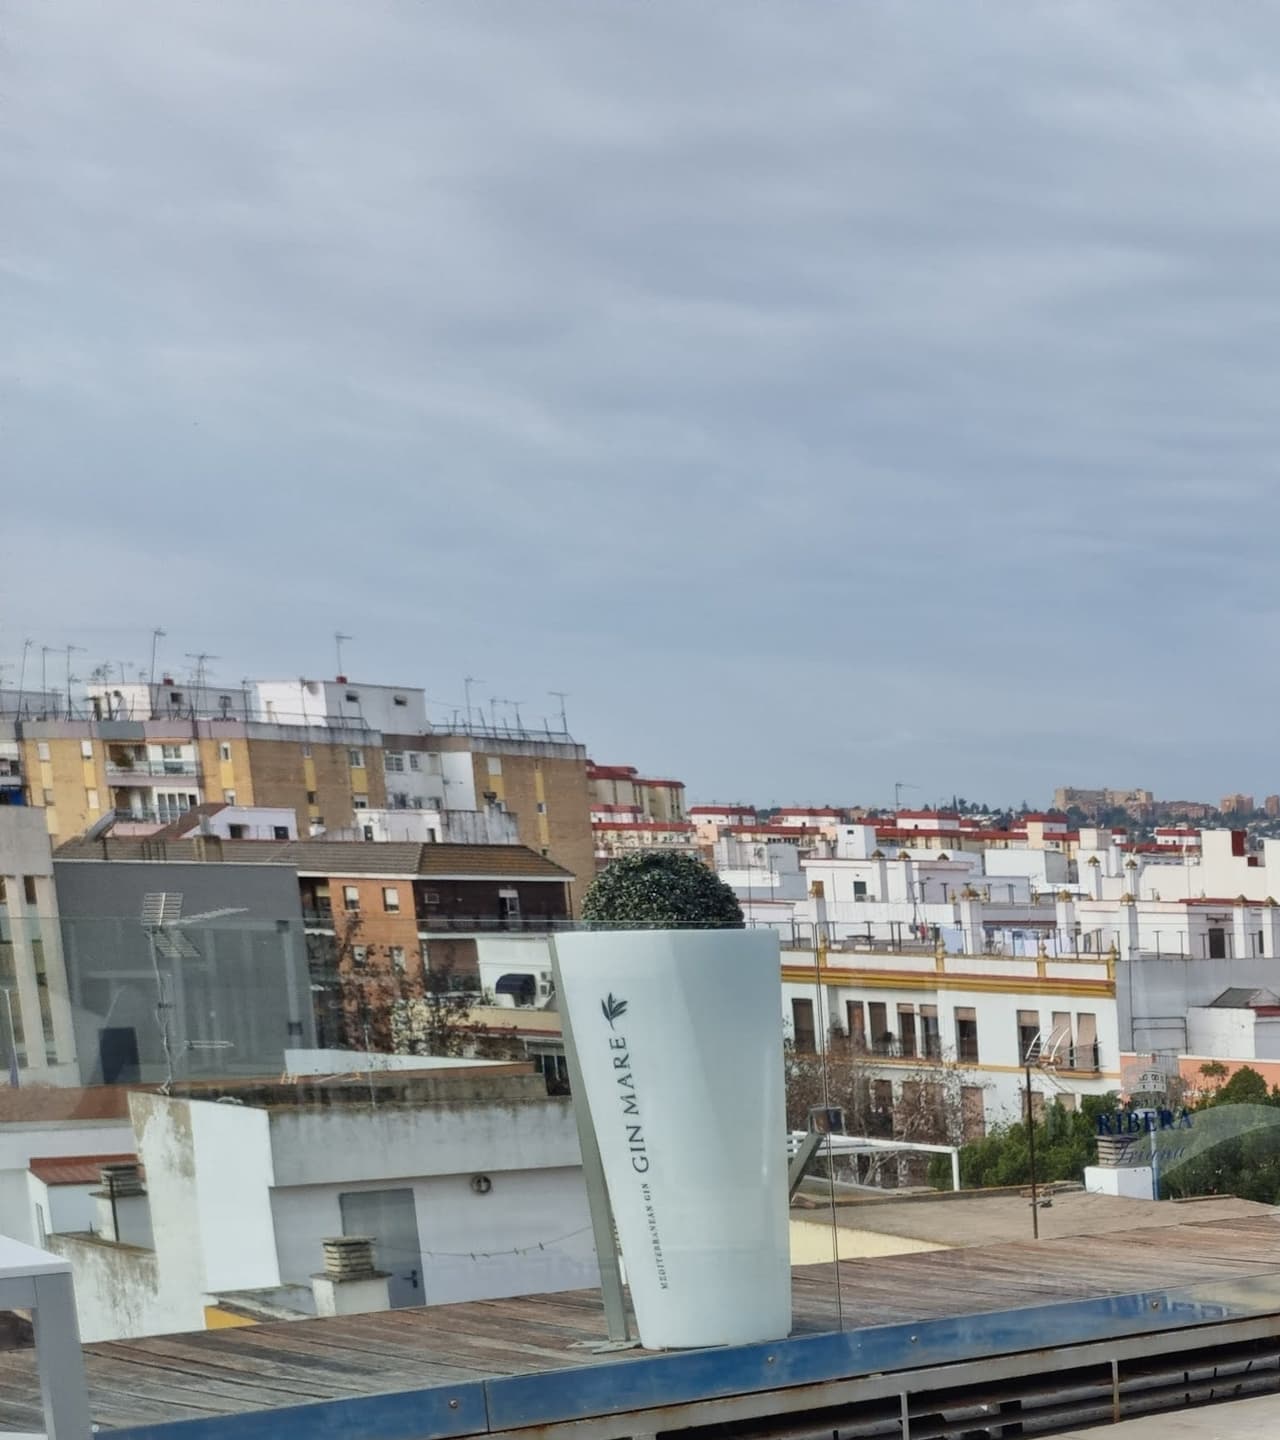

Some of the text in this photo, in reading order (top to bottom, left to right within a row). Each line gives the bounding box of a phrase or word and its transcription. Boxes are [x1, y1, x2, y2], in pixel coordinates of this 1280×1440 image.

[609, 1037, 649, 1173] GIN MARE
[1096, 1110, 1192, 1135] RIBERA
[641, 1183, 668, 1290] MEDITERRANEAN GIN
